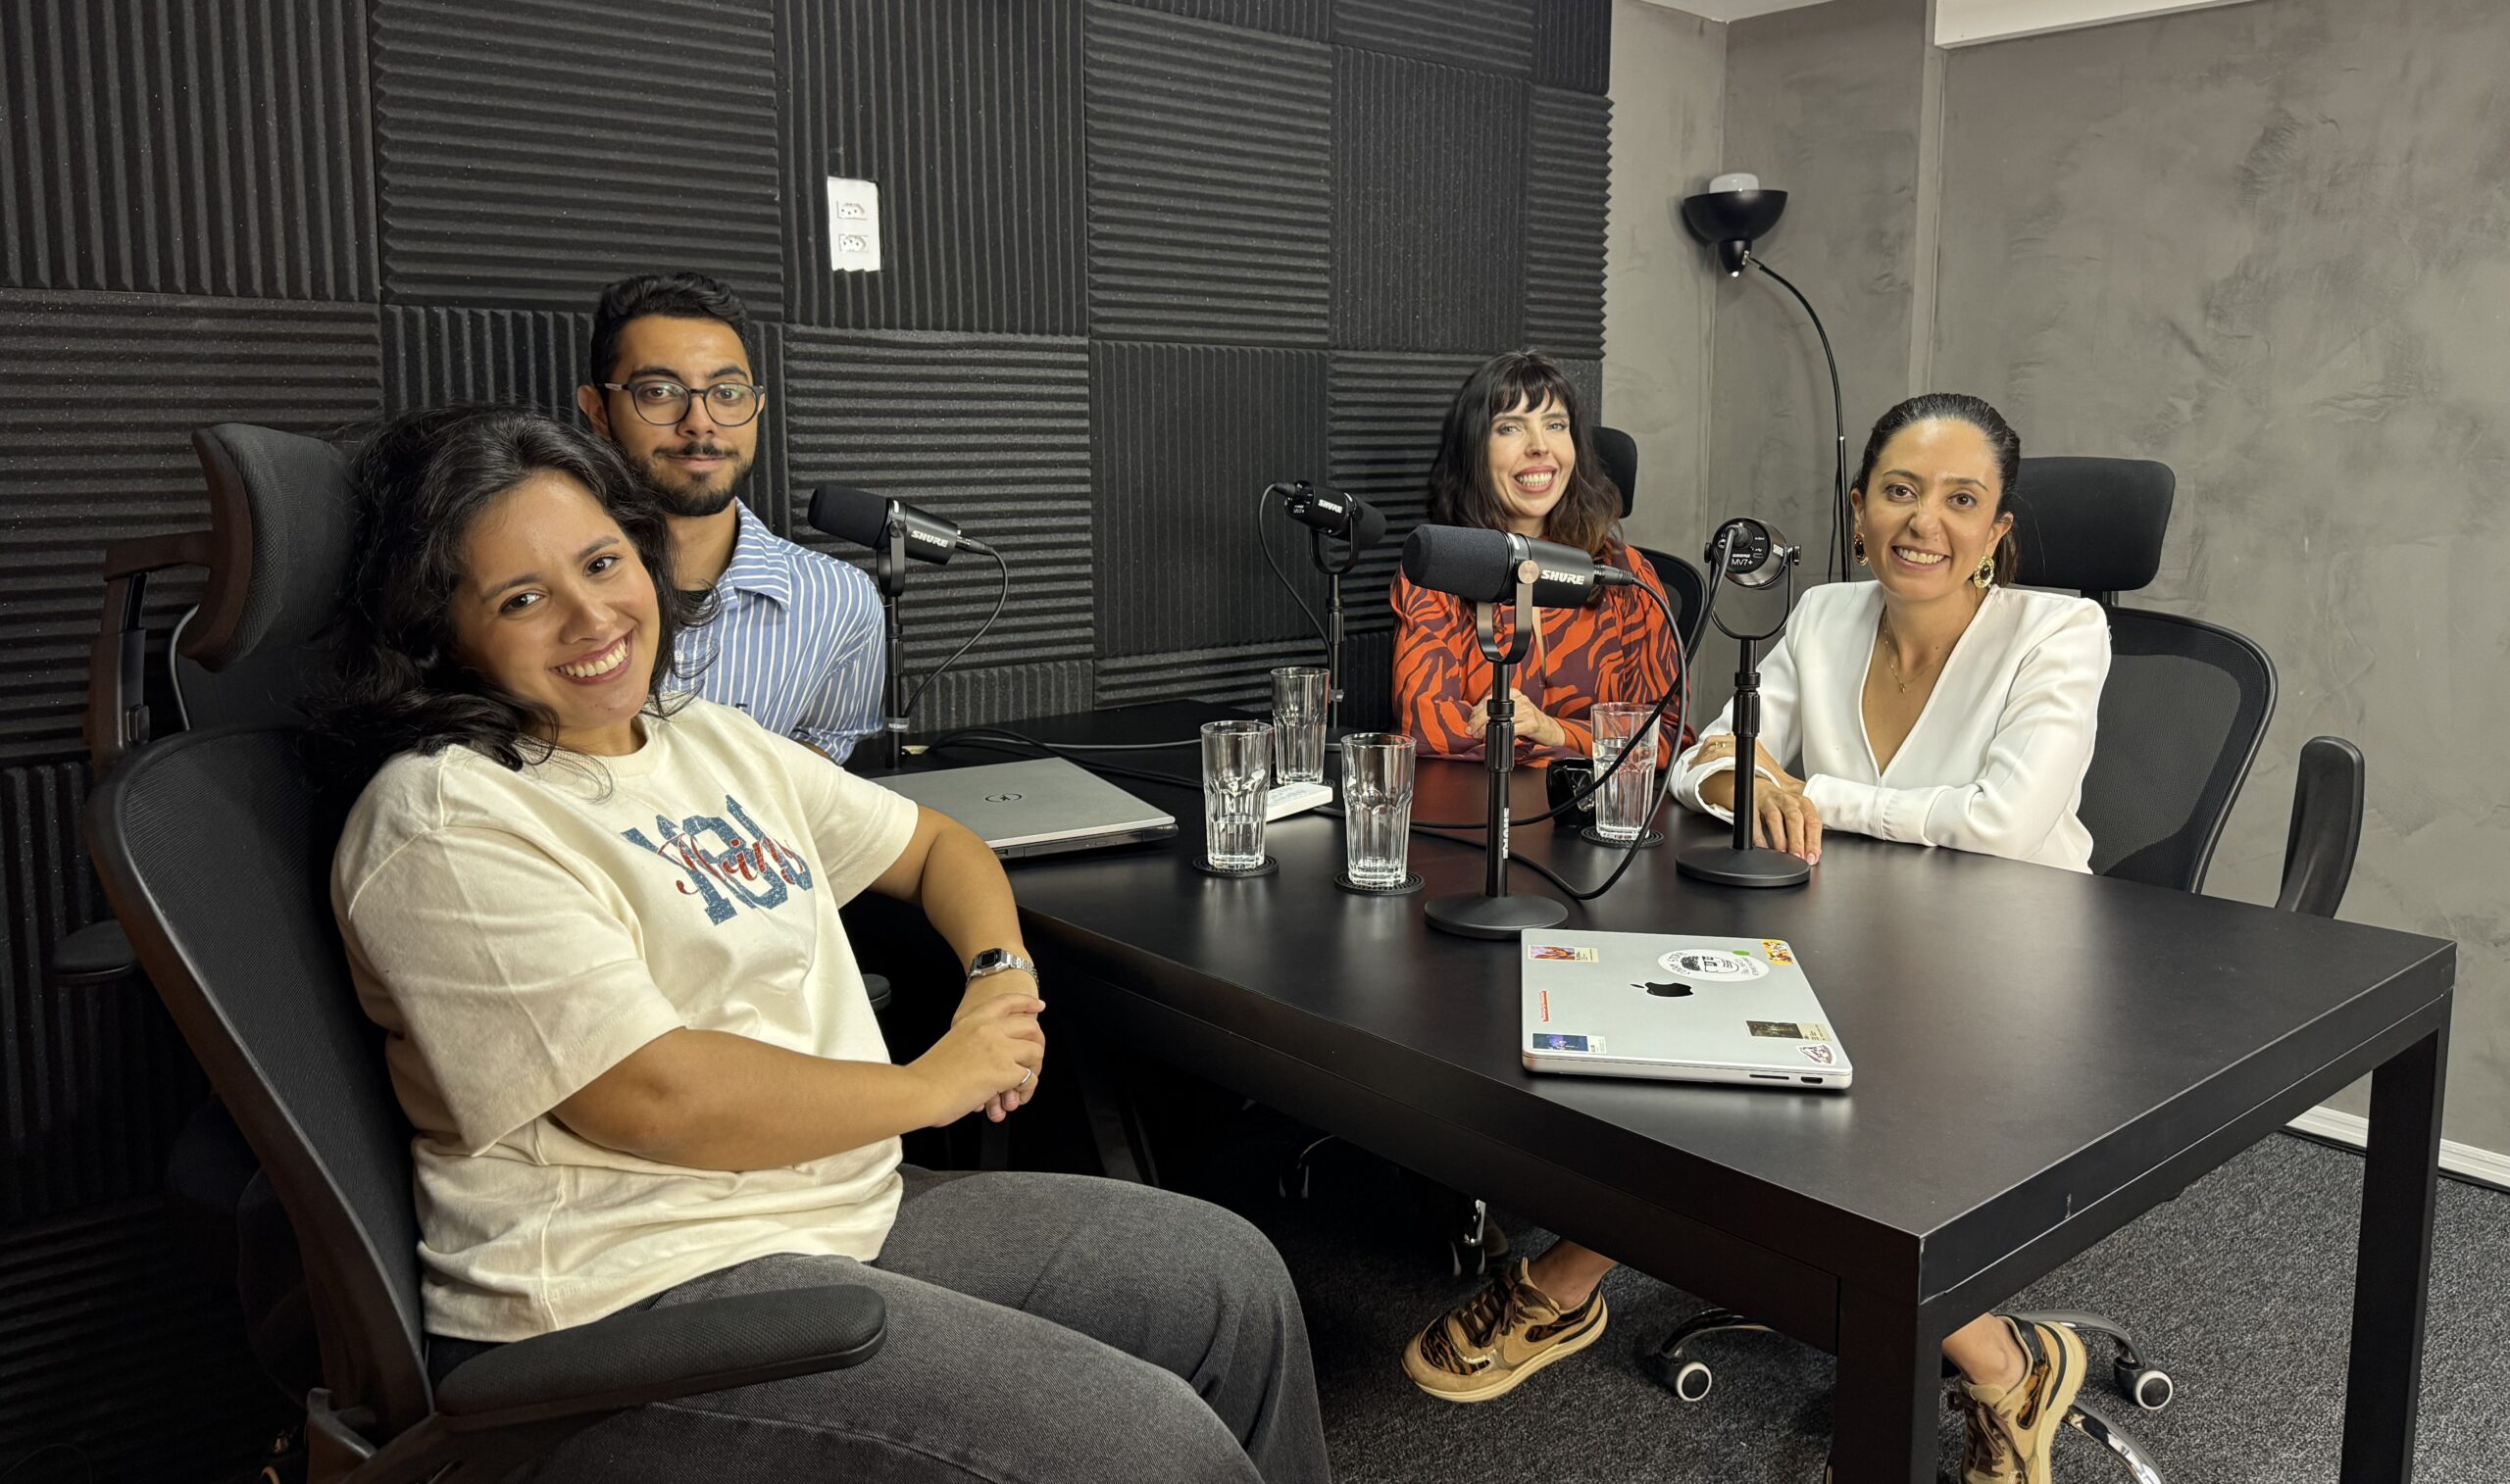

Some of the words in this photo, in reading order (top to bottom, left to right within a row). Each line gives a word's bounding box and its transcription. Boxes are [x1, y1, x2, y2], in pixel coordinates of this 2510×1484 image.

[1318, 499, 1343, 514] SHURE
[911, 530, 948, 548] SHURE
[1540, 569, 1585, 585] SHURE
